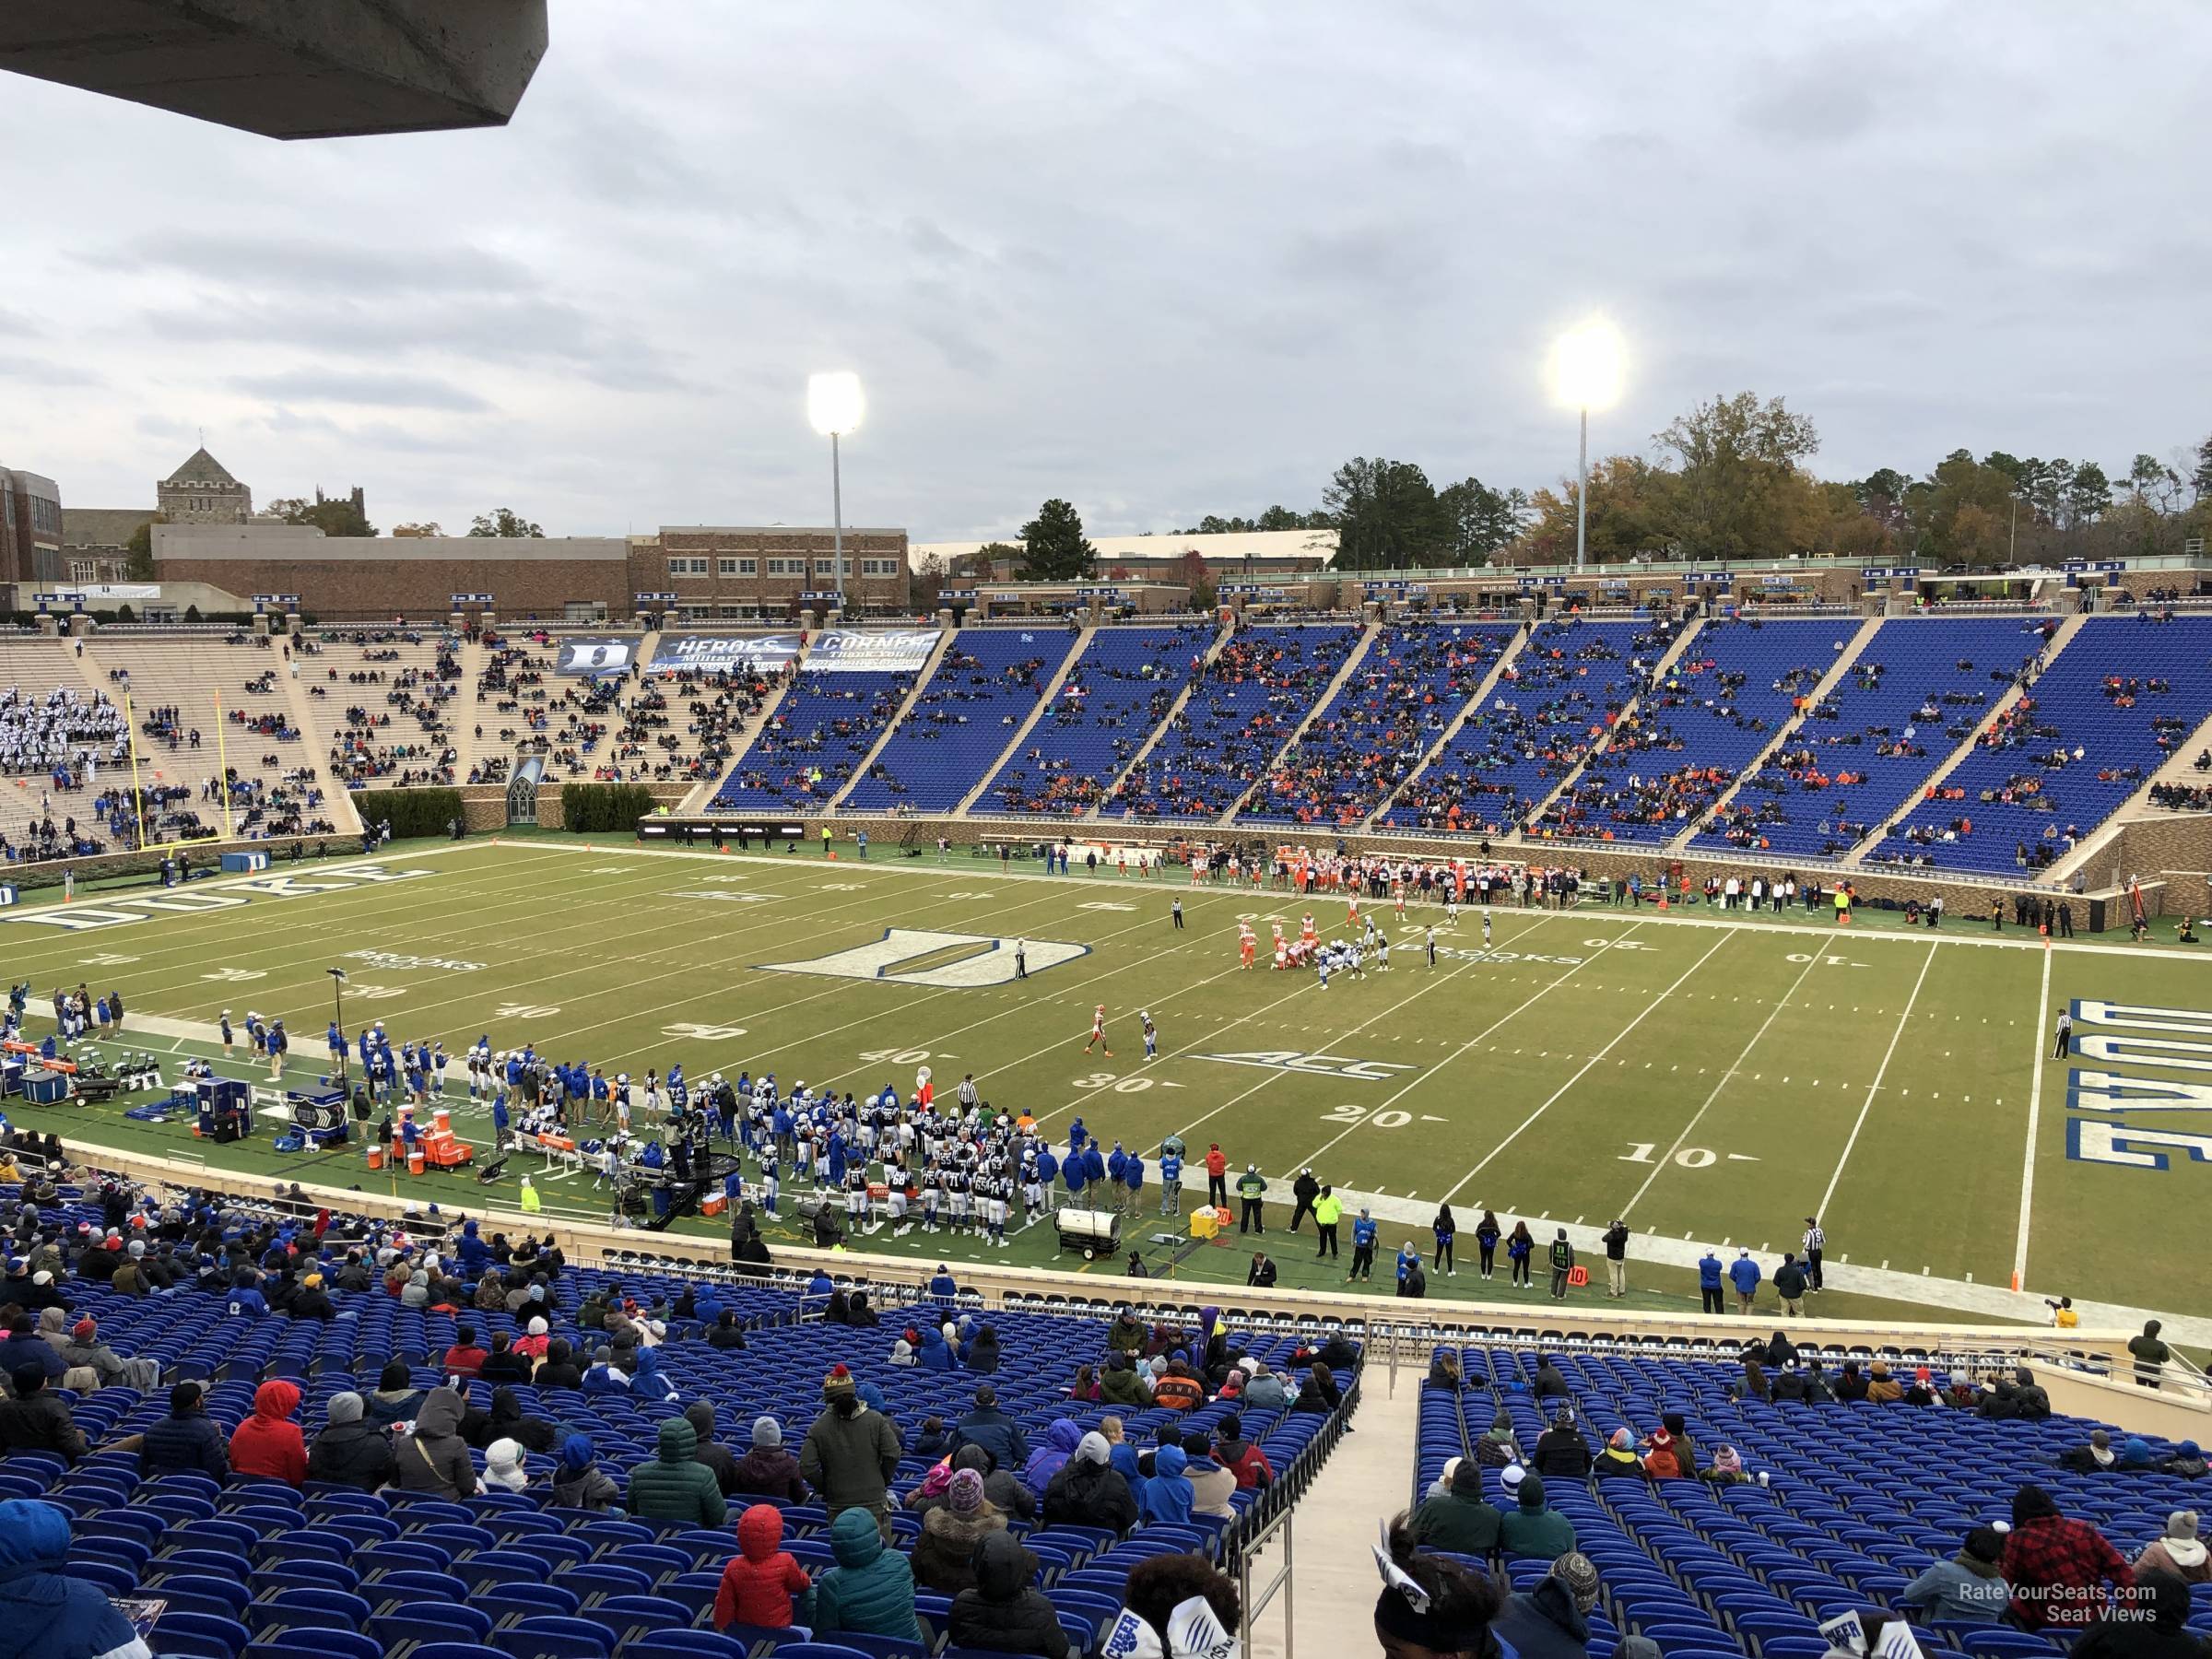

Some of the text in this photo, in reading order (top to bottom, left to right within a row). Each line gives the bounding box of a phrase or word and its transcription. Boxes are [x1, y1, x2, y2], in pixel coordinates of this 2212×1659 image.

[677, 641, 779, 654] HEROES
[823, 636, 929, 650] CORNER
[681, 654, 744, 663] Military
[4, 865, 438, 930] DUKE
[1393, 944, 1583, 964] BROOKS
[341, 951, 486, 971] BROOKS
[341, 986, 406, 998] 30
[858, 1048, 931, 1064] 40
[1181, 1051, 1422, 1081] ACC
[1072, 1073, 1155, 1092] 30
[1319, 1104, 1413, 1128] 20
[932, 1125, 942, 1135] 53
[985, 1144, 995, 1154] 60
[1617, 1142, 1718, 1169] 10
[457, 1153, 465, 1161] G
[941, 1156, 952, 1165] 55
[991, 1159, 1003, 1171] 63
[851, 1173, 861, 1184] 61
[892, 1173, 905, 1186] 68
[924, 1173, 935, 1185] 75
[949, 1174, 959, 1187] 71
[976, 1179, 986, 1191] 65
[989, 1184, 1000, 1195] 74
[1217, 1210, 1227, 1223] 20
[1815, 1231, 1822, 1242] S
[1570, 1268, 1583, 1282] 10
[1106, 1614, 1141, 1659] CHEER
